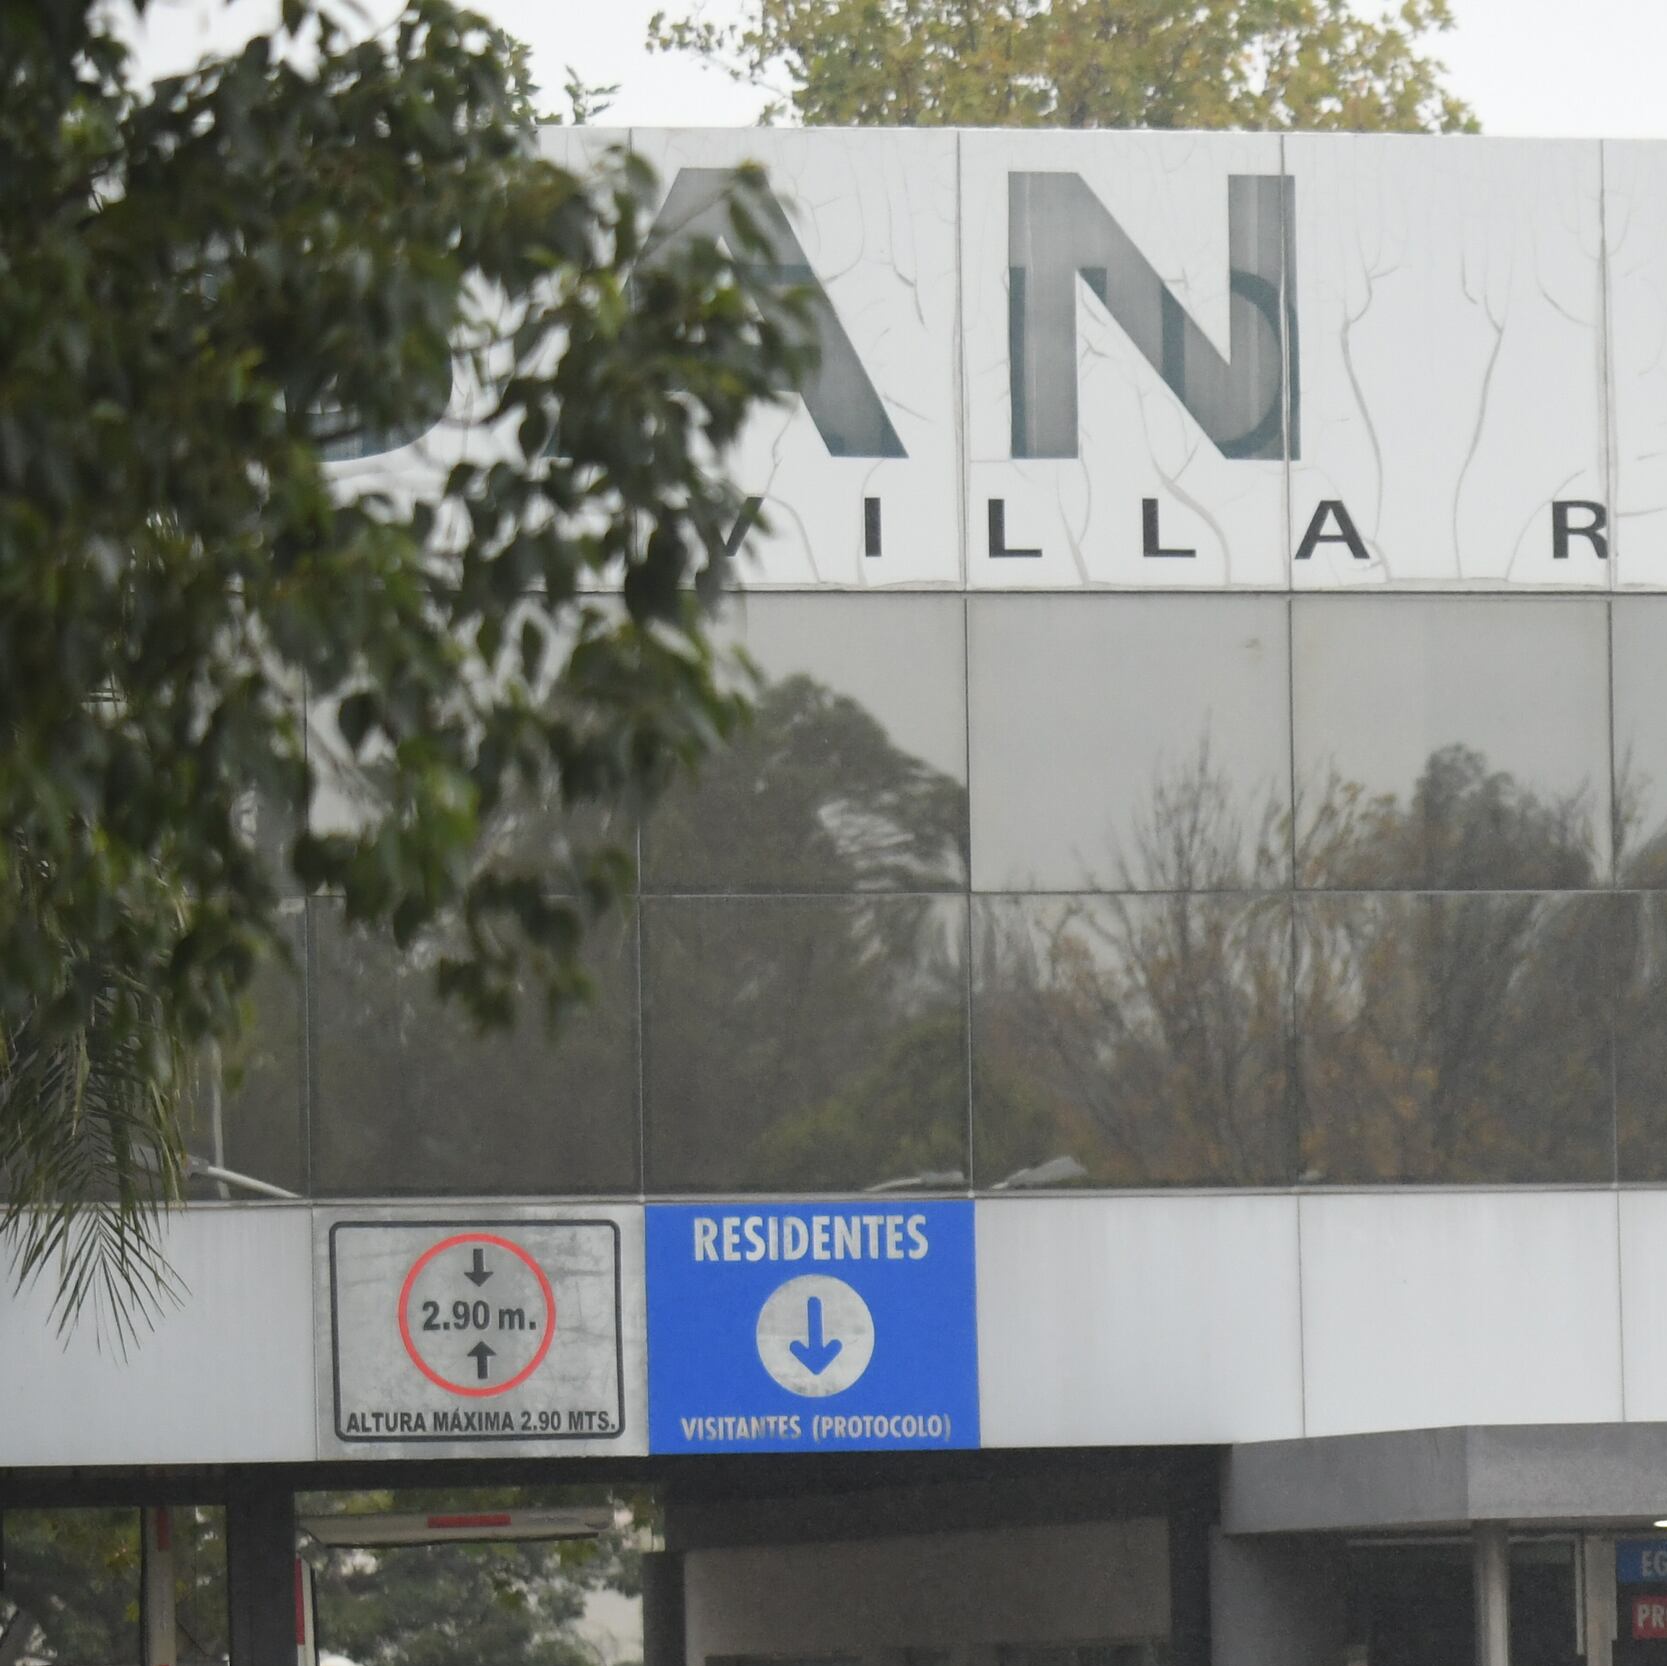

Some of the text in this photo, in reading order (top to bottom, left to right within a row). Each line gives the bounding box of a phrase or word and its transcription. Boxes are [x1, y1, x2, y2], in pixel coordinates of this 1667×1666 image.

[694, 1214, 929, 1263] RESIDENTES
[421, 1300, 538, 1333] 2.90 m.
[346, 1407, 617, 1434] ALTURA MÁXIMA 2.90 MTS.
[681, 1413, 952, 1443] VISITANTES (PROTOCOLO)
